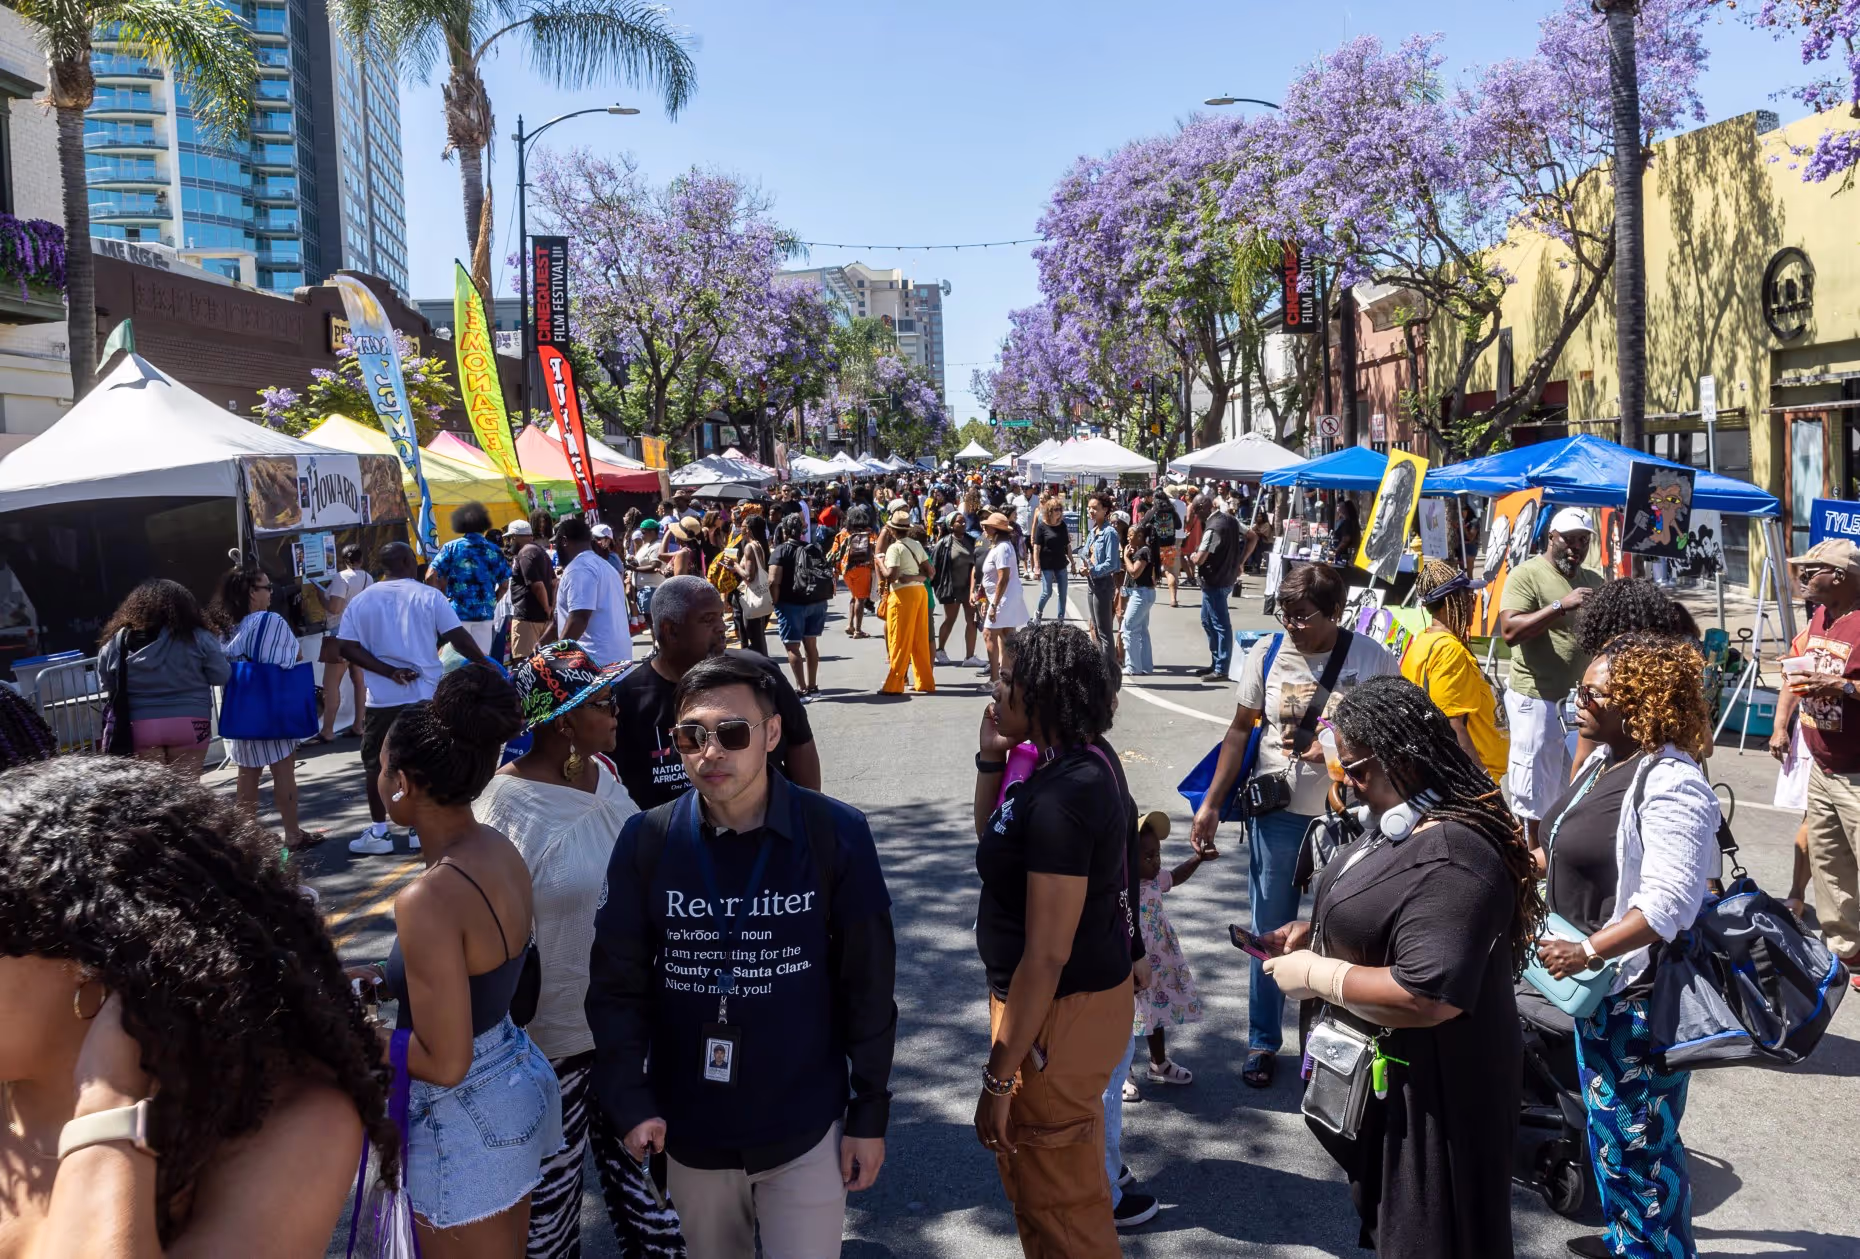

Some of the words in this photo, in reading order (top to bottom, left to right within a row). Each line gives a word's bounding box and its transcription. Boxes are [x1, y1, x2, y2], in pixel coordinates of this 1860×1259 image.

[99, 240, 170, 271] MERGE
[535, 246, 551, 341] CINEQUEST
[552, 260, 565, 311] FESTIVAL
[1285, 241, 1299, 325] CINEQUE
[1301, 298, 1313, 323] FILM
[553, 315, 566, 342] FILM
[308, 465, 358, 519] HOWARD
[1825, 510, 1860, 536] TYLE
[741, 930, 772, 940] noun
[671, 950, 691, 959] am
[693, 949, 756, 963] recruting
[760, 949, 779, 960] for
[782, 946, 801, 958] the
[664, 962, 711, 978] County
[732, 966, 772, 978] Santa
[775, 960, 812, 975] Clara.
[665, 977, 691, 991] Nice
[693, 982, 705, 993] to
[708, 985, 740, 994] met
[743, 982, 772, 997] you!
